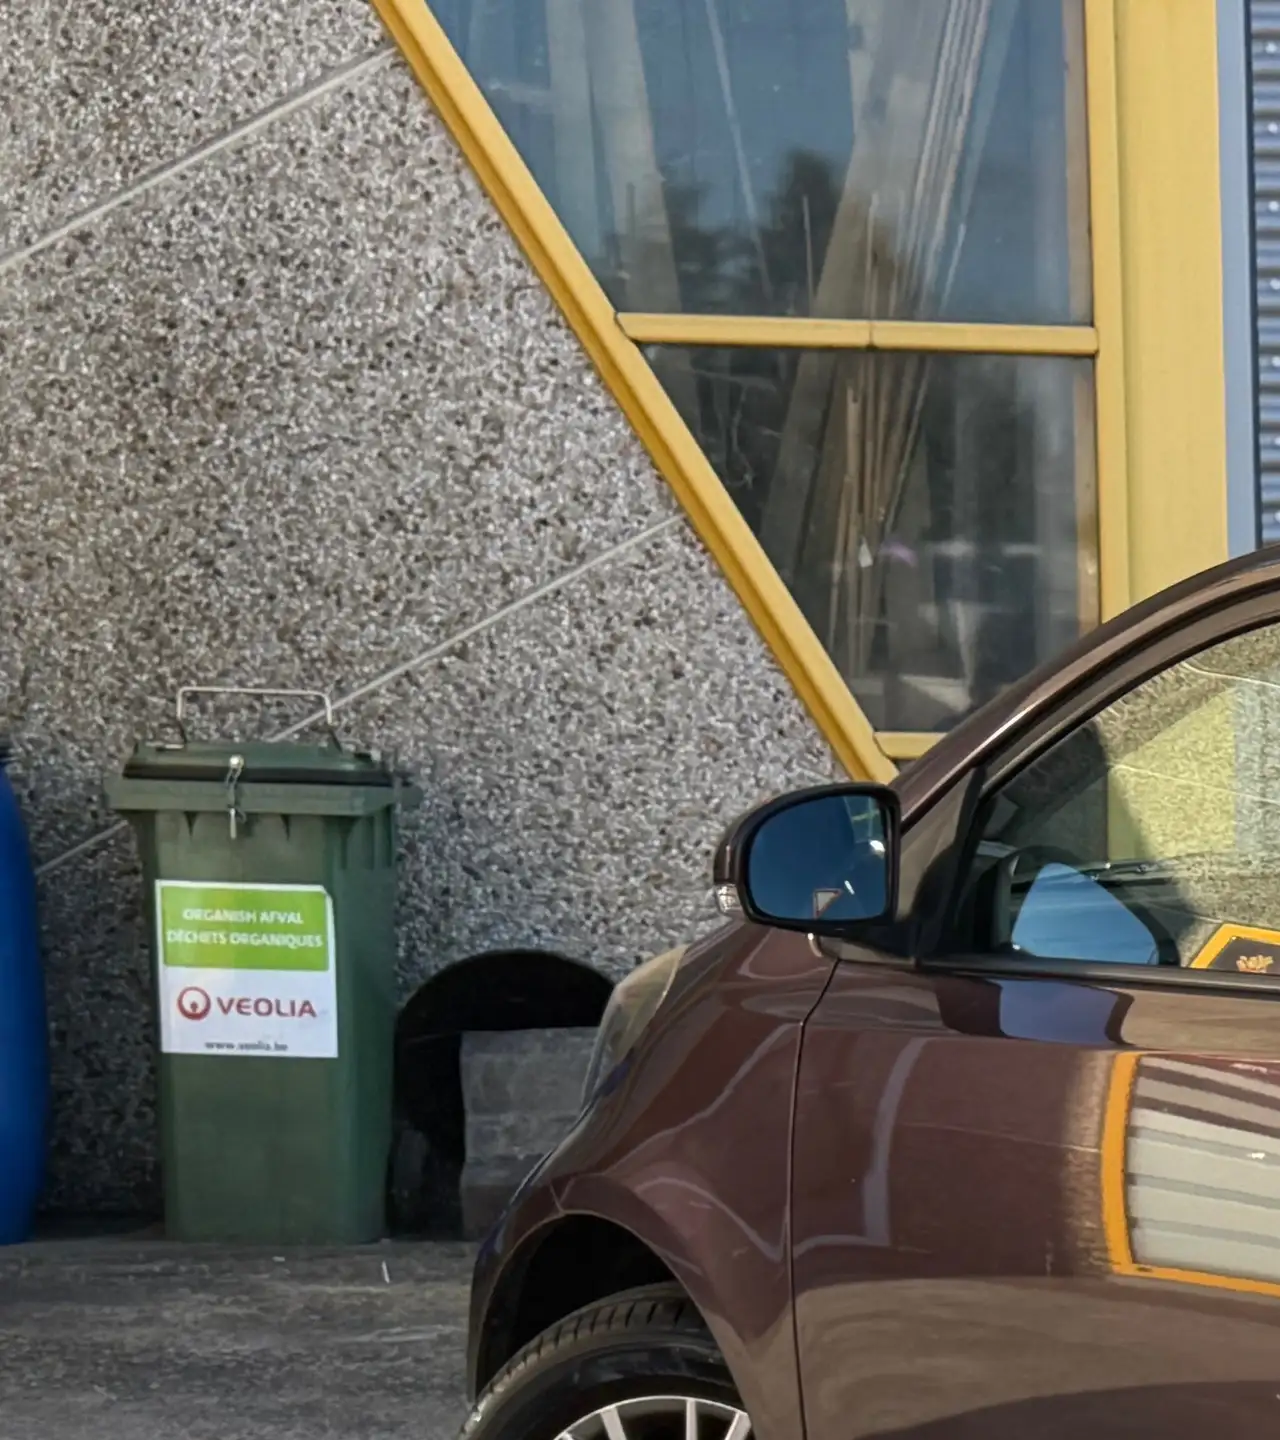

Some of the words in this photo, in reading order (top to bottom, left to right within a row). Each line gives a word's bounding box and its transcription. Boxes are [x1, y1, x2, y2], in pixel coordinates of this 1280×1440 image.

[259, 911, 304, 925] AFVAL
[229, 931, 323, 949] ORGANIQUES
[216, 997, 318, 1018] VEOLIA
